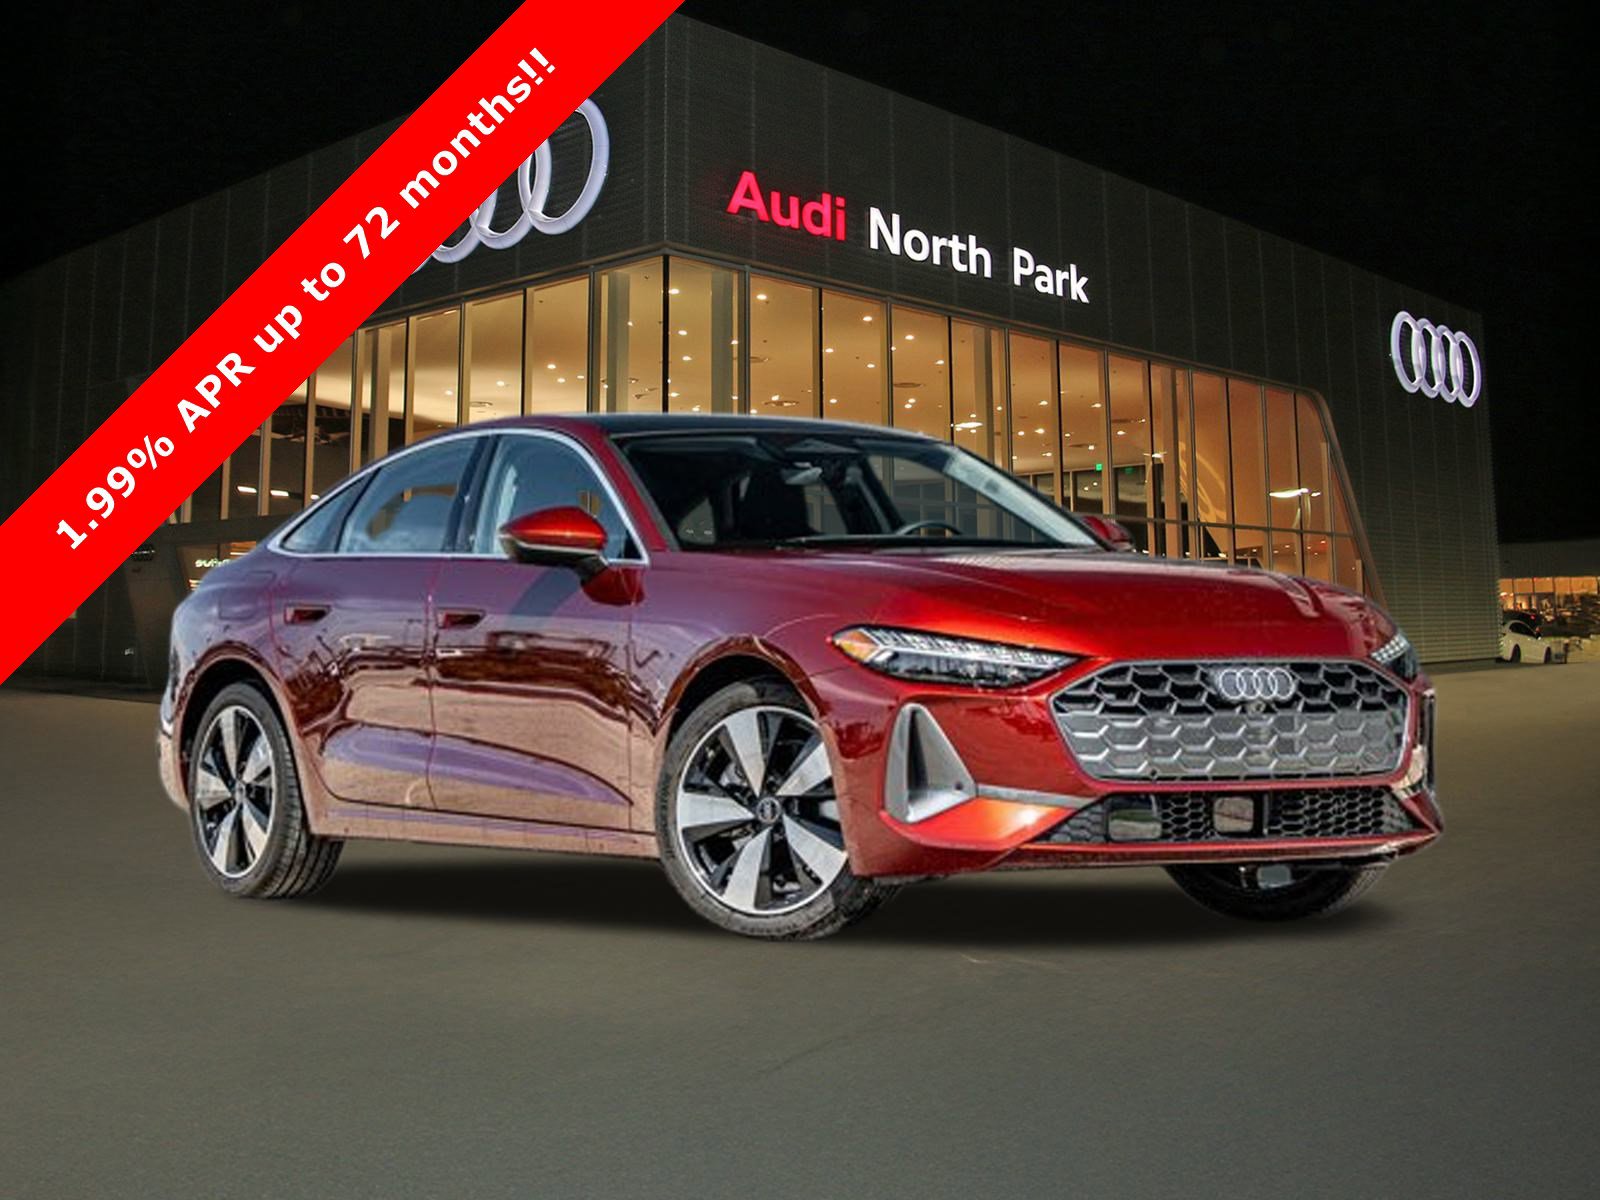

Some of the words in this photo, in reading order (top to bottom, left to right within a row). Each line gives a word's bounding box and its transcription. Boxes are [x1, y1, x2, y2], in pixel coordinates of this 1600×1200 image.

[726, 170, 846, 241] Audi
[869, 206, 992, 279] North
[1012, 246, 1090, 304] Park
